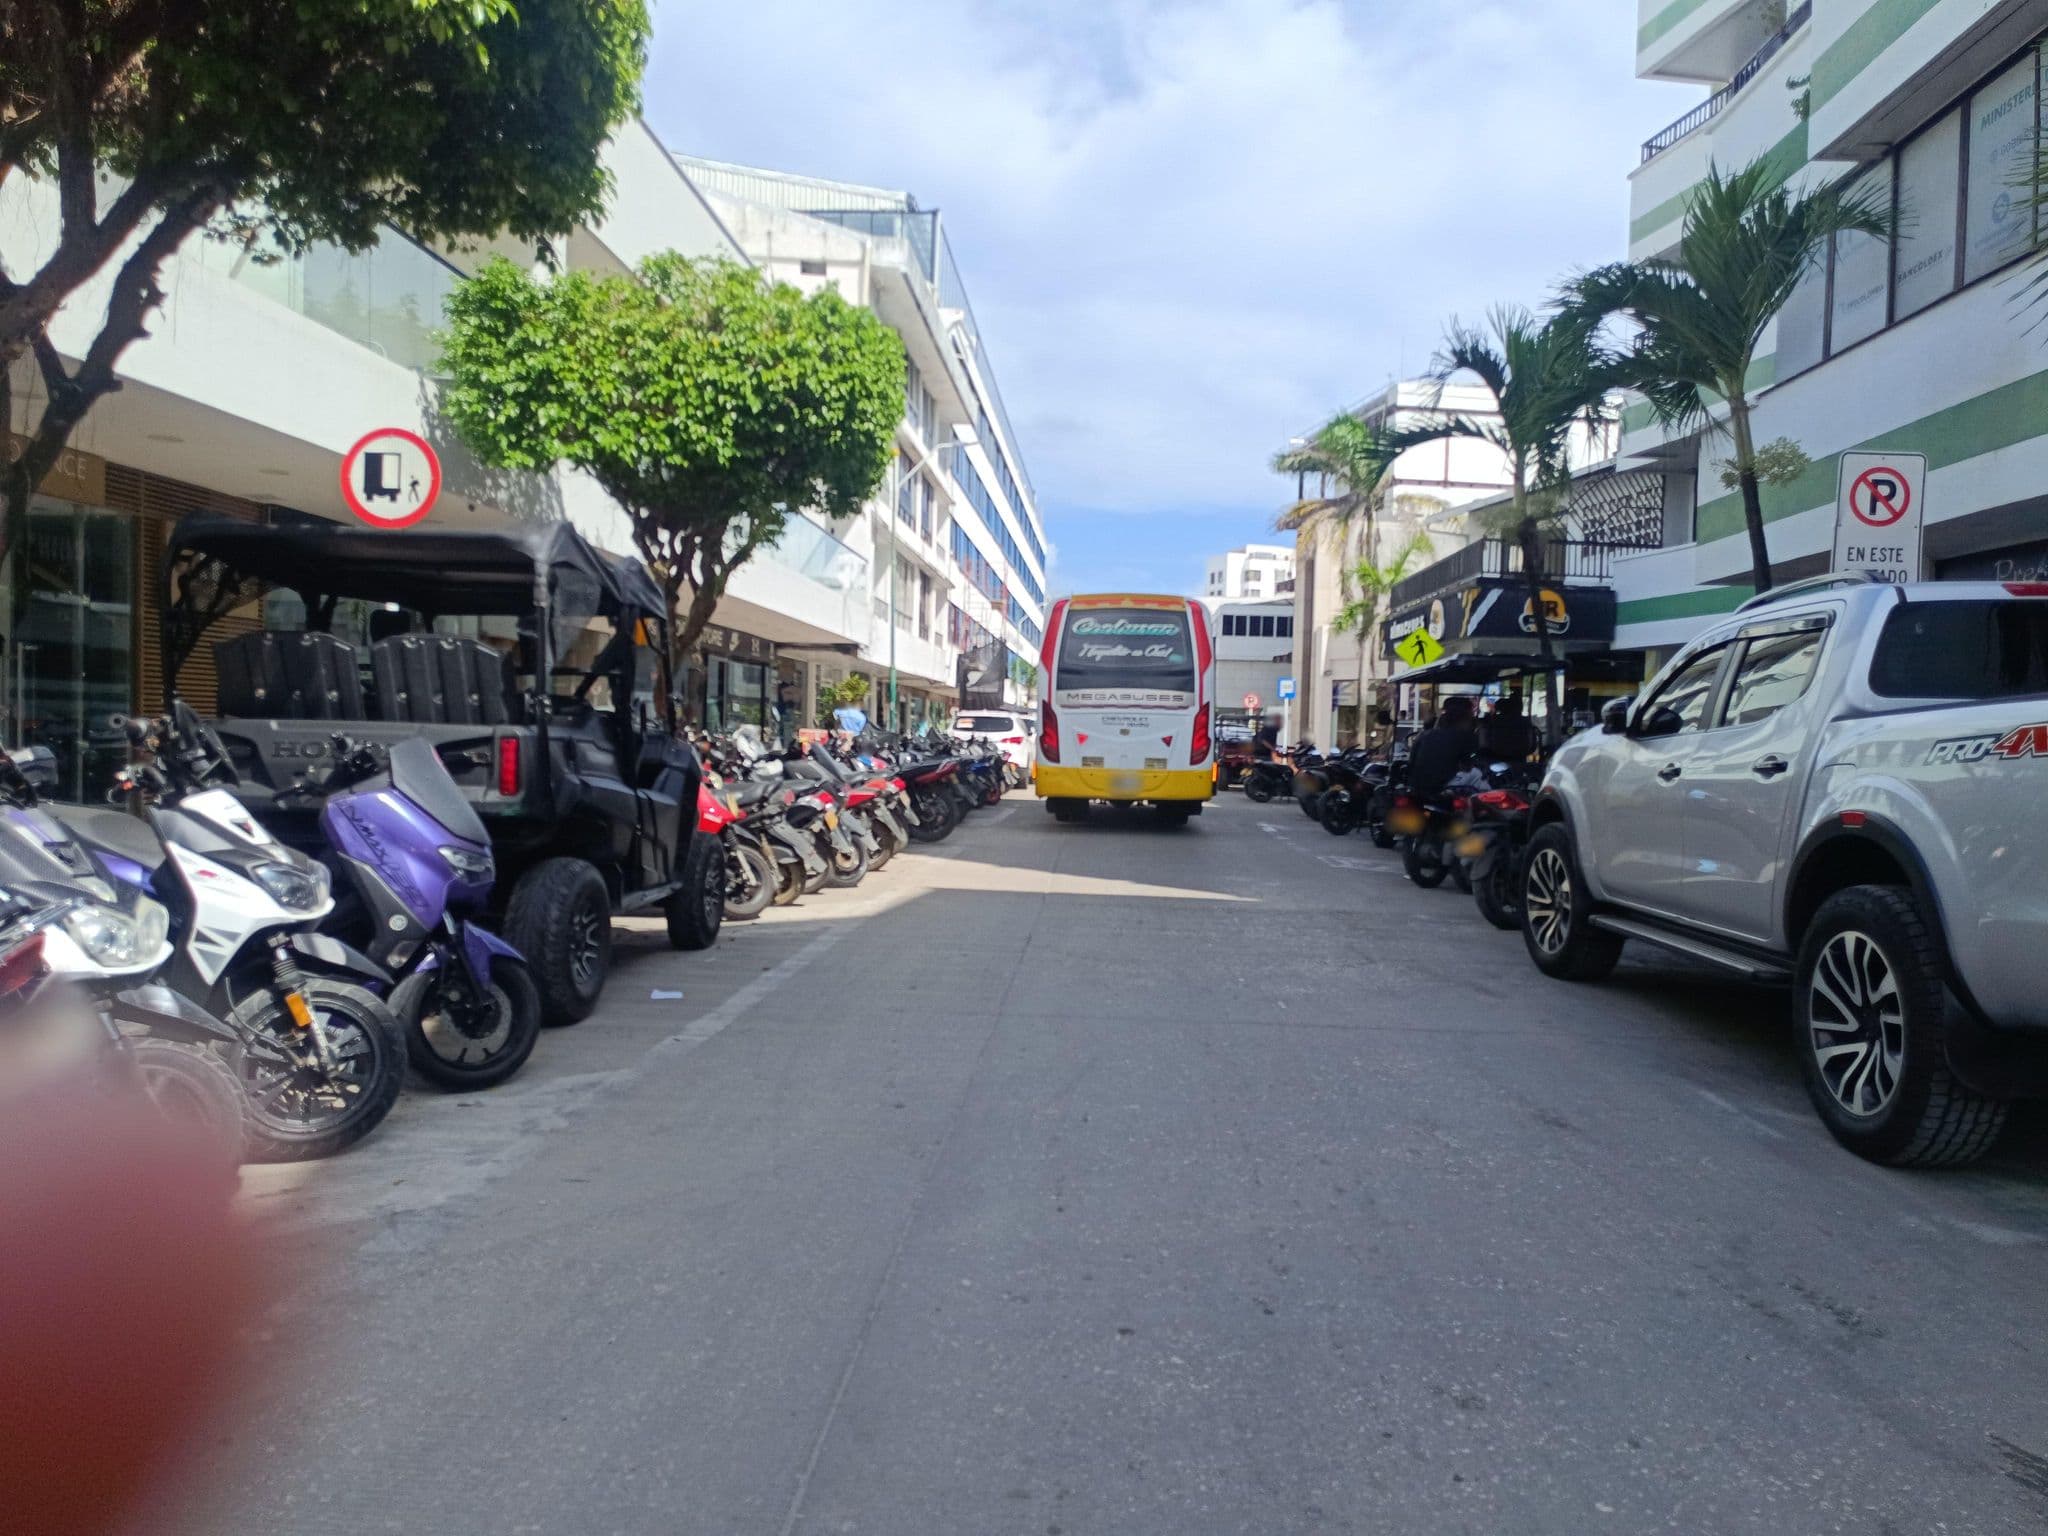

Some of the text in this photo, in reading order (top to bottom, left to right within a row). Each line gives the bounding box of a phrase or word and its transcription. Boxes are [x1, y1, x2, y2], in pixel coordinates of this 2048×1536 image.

[1847, 546, 1904, 563] EN ESTE
[1066, 692, 1185, 703] MEGABUSES
